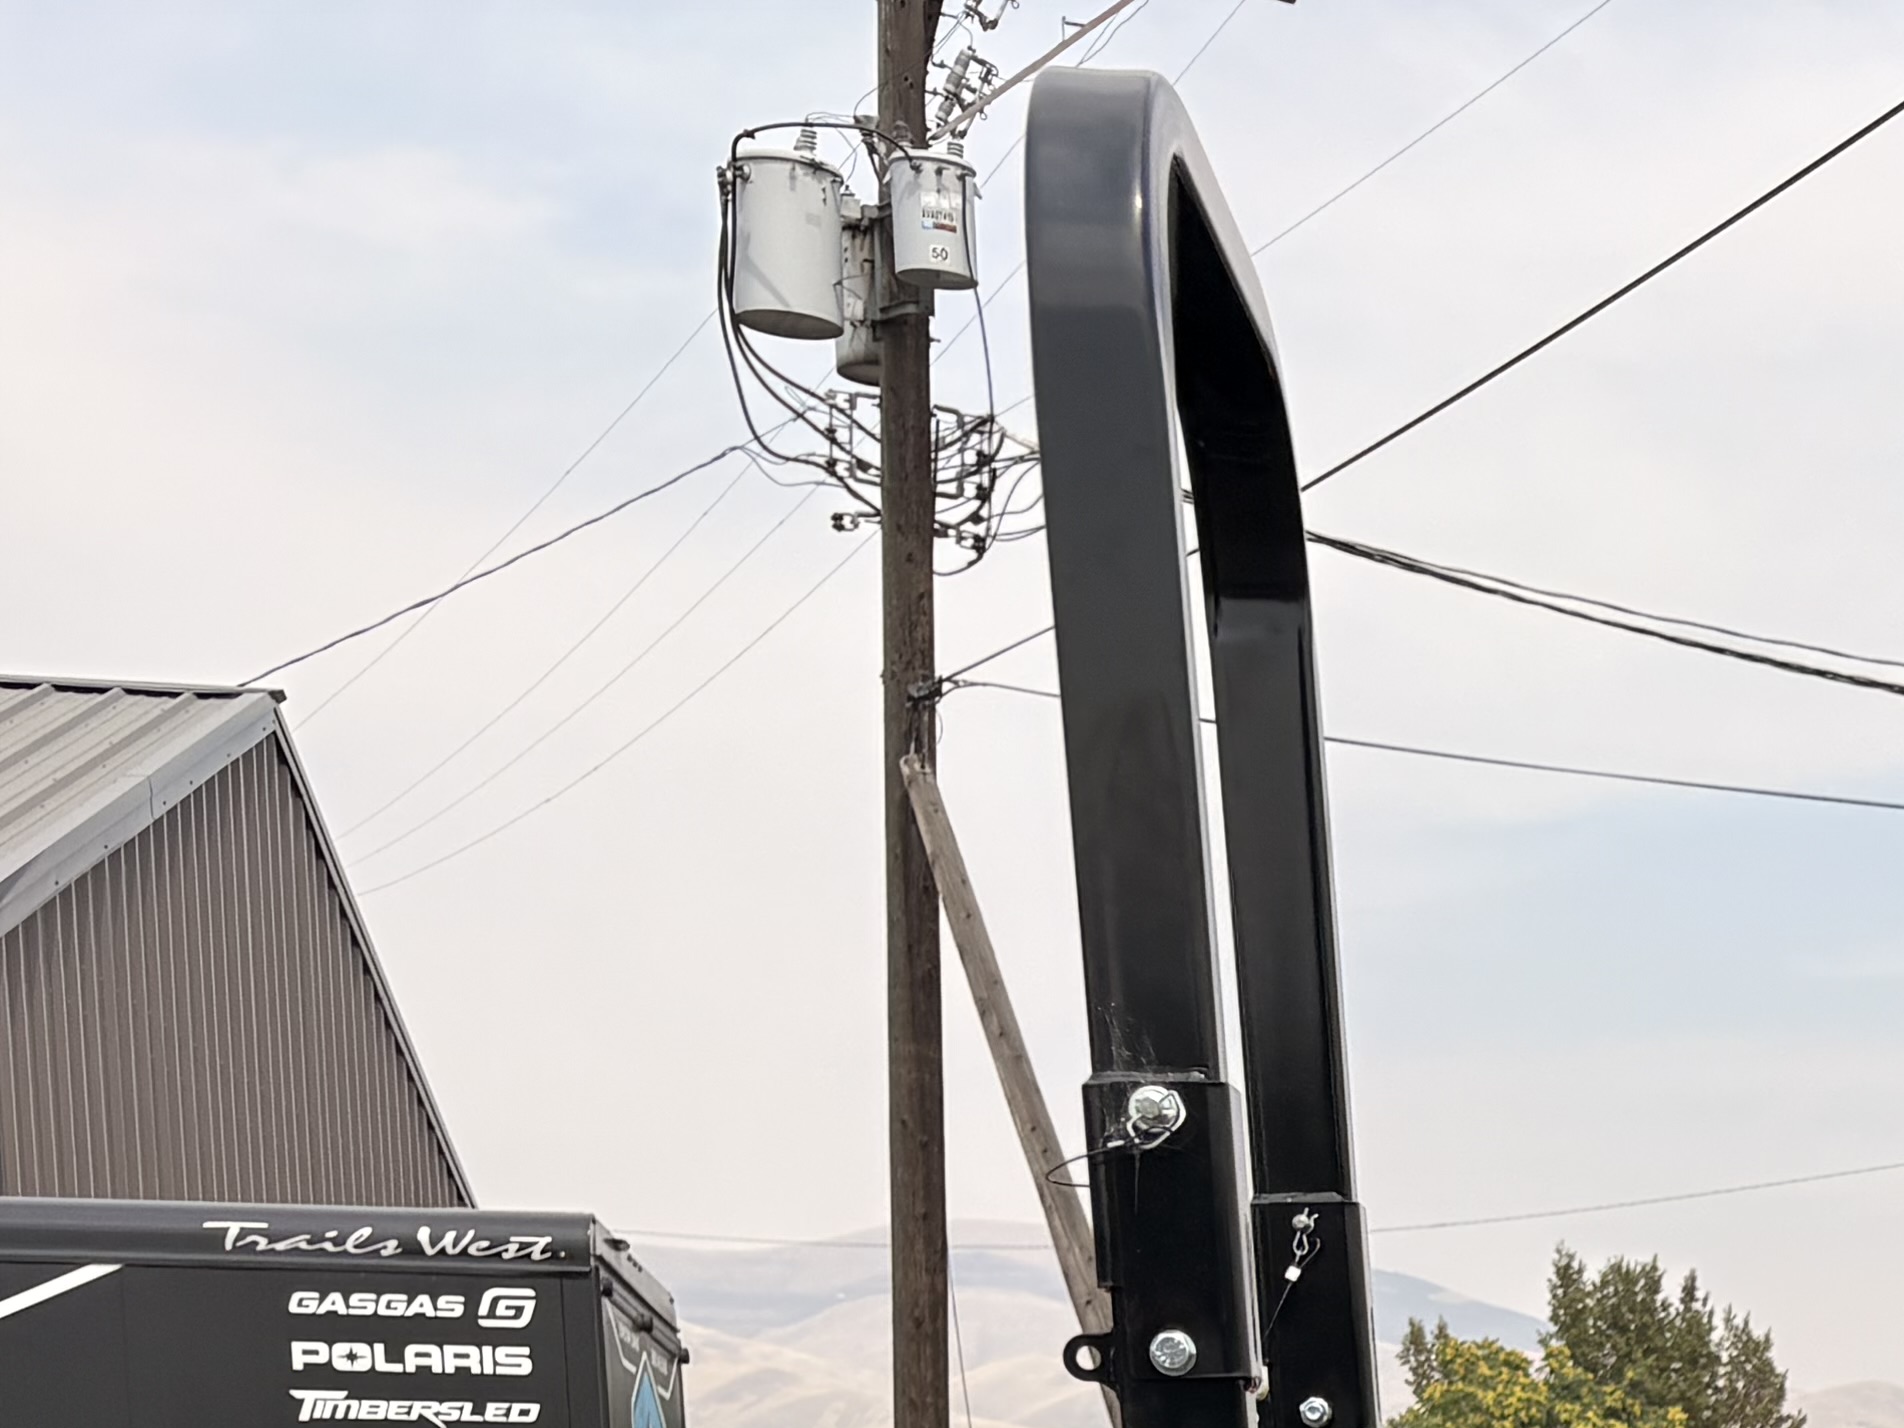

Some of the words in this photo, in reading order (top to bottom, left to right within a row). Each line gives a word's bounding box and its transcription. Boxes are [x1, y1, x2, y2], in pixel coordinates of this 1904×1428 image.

[932, 247, 948, 261] 50
[202, 1221, 403, 1257] Trails
[288, 1290, 466, 1318] GASGAS
[290, 1340, 534, 1376] POLARIS
